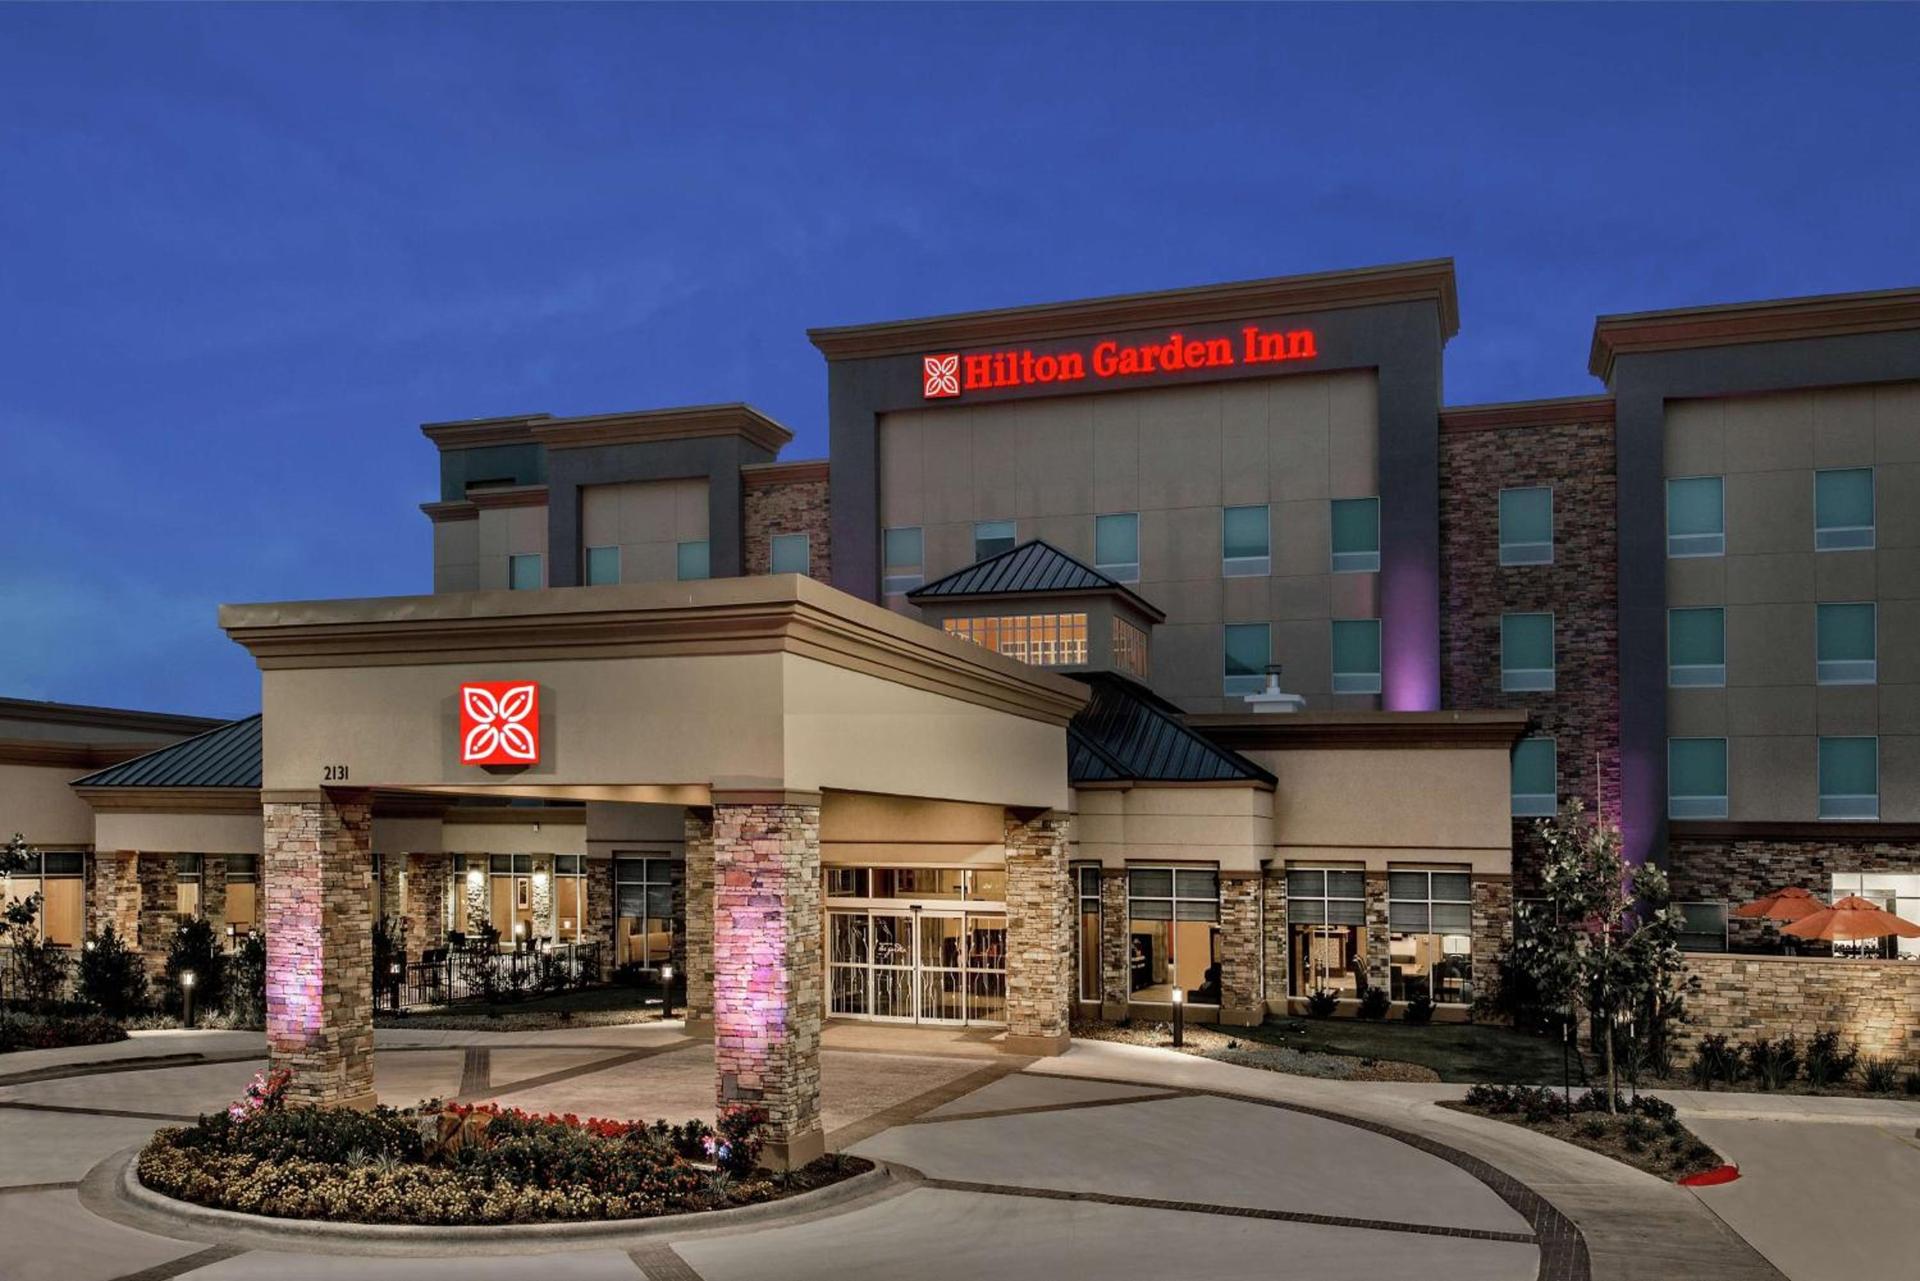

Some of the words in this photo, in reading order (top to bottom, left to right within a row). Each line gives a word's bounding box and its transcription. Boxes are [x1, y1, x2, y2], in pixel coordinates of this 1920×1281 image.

[963, 350, 1085, 390] Hilton
[1092, 334, 1234, 377] Garden
[1243, 327, 1317, 363] Inn
[323, 765, 349, 780] 2131
